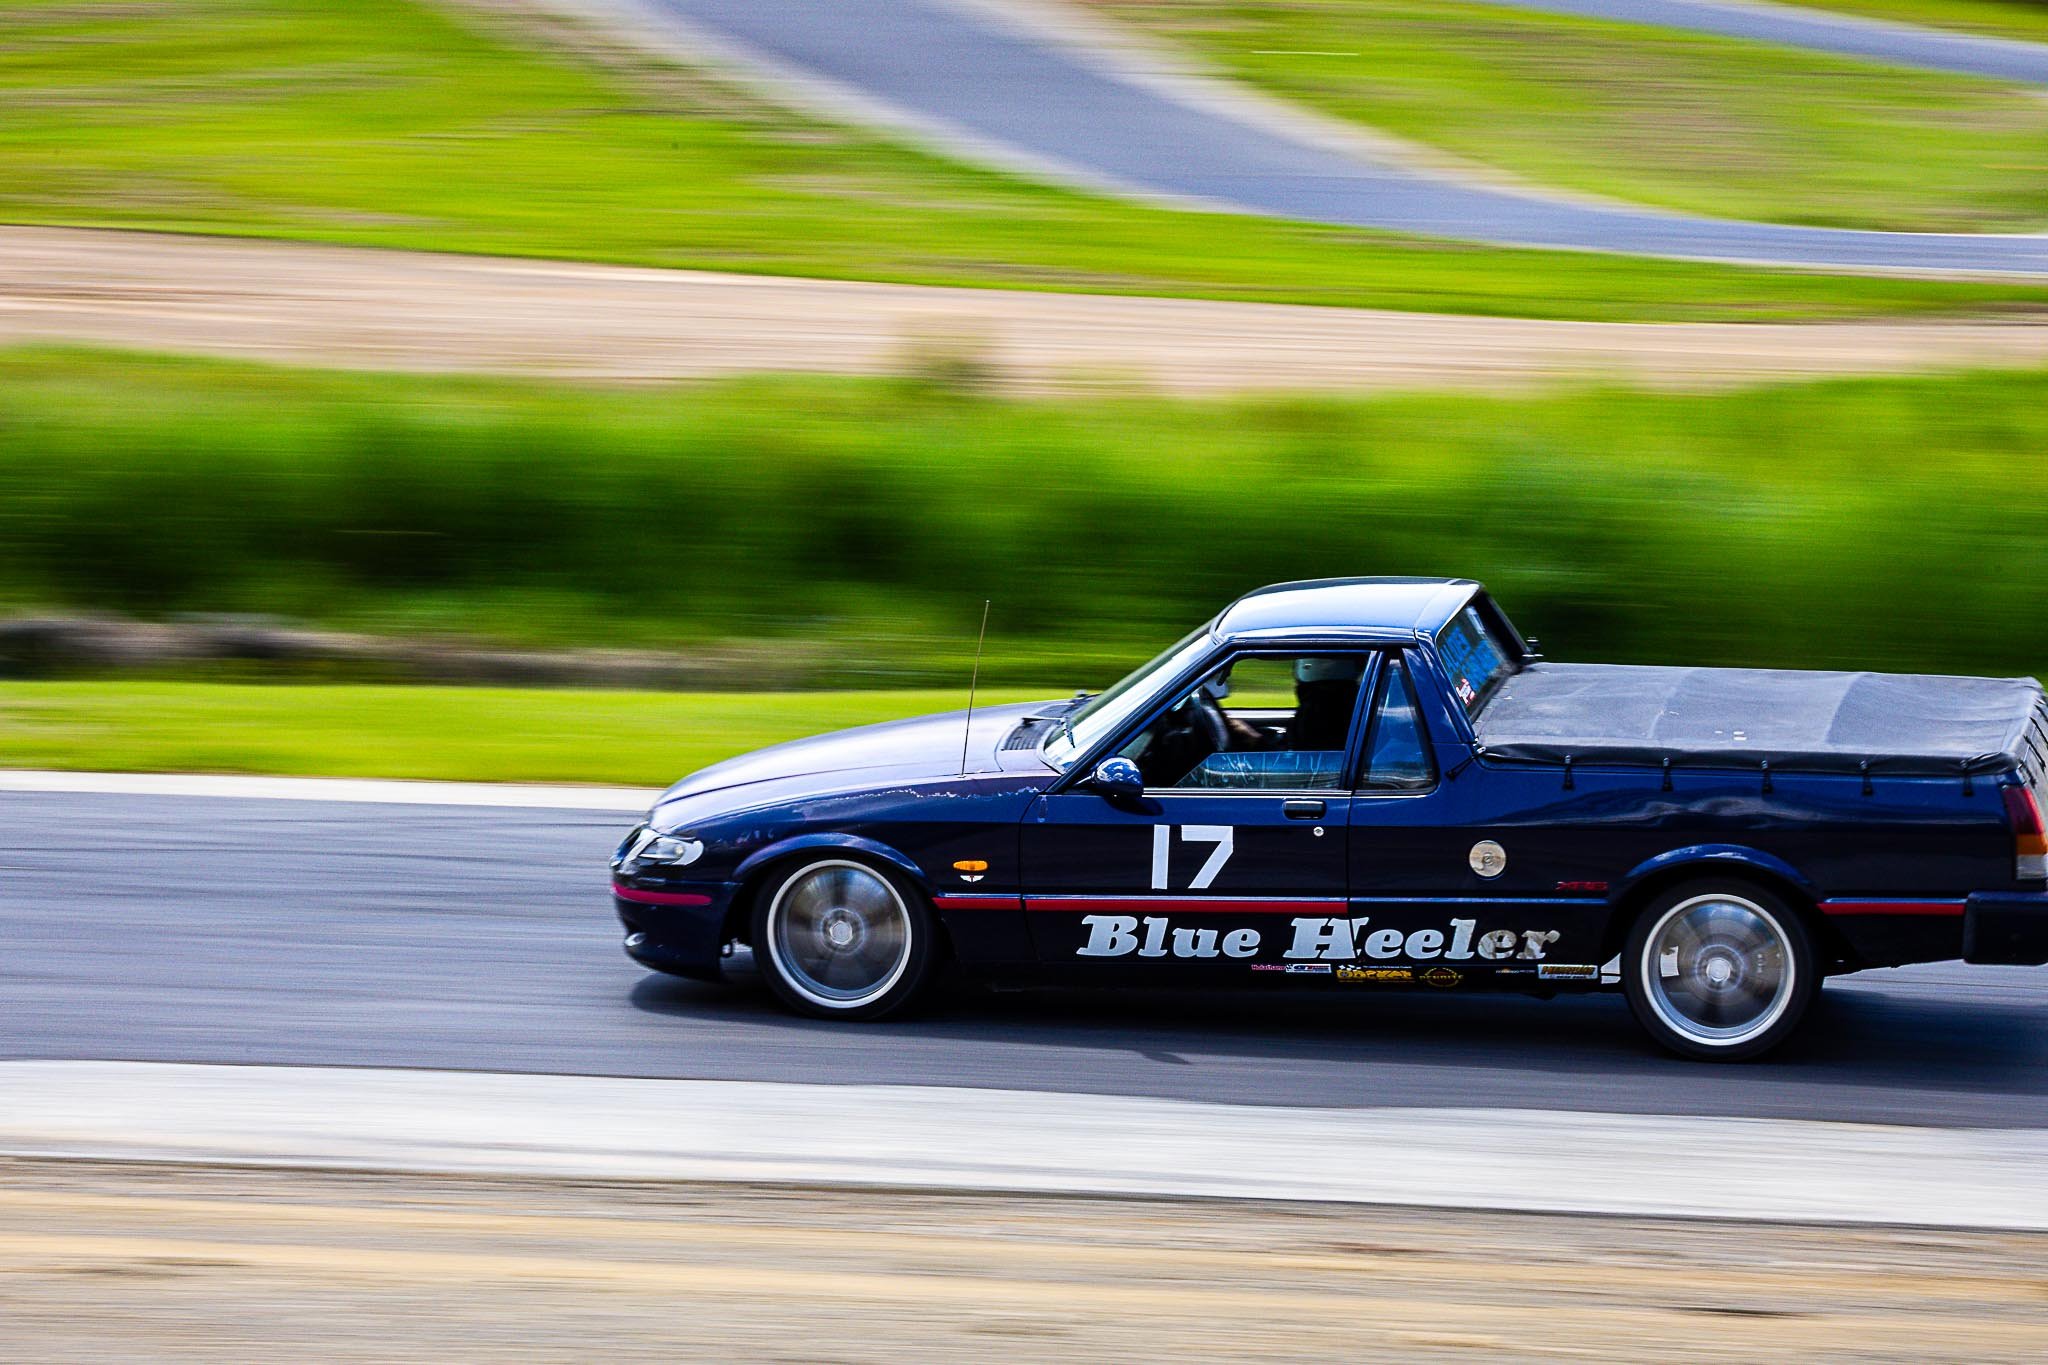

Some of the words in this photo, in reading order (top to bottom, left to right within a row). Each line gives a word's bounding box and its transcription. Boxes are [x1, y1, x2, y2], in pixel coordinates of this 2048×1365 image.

[1152, 824, 1234, 889] 17
[1076, 914, 1261, 958] Blue
[1282, 916, 1561, 960] Heeler
